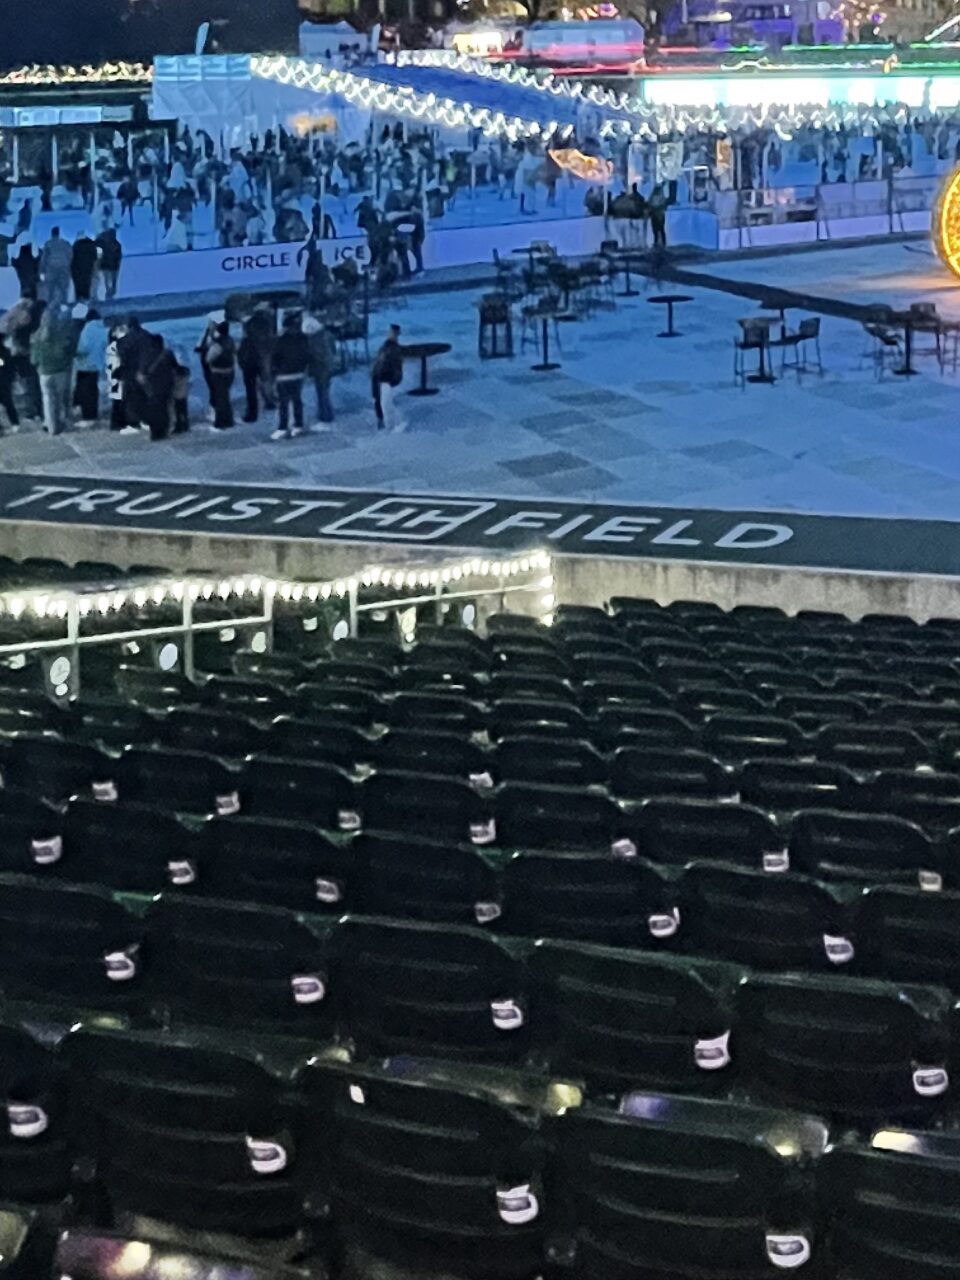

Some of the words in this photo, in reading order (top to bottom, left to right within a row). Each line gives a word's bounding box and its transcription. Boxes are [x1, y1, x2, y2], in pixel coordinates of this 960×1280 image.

[221, 251, 290, 272] CIRCLE
[334, 244, 365, 262] ICE
[5, 485, 347, 523] TRUIST
[484, 511, 794, 549] FIELD
